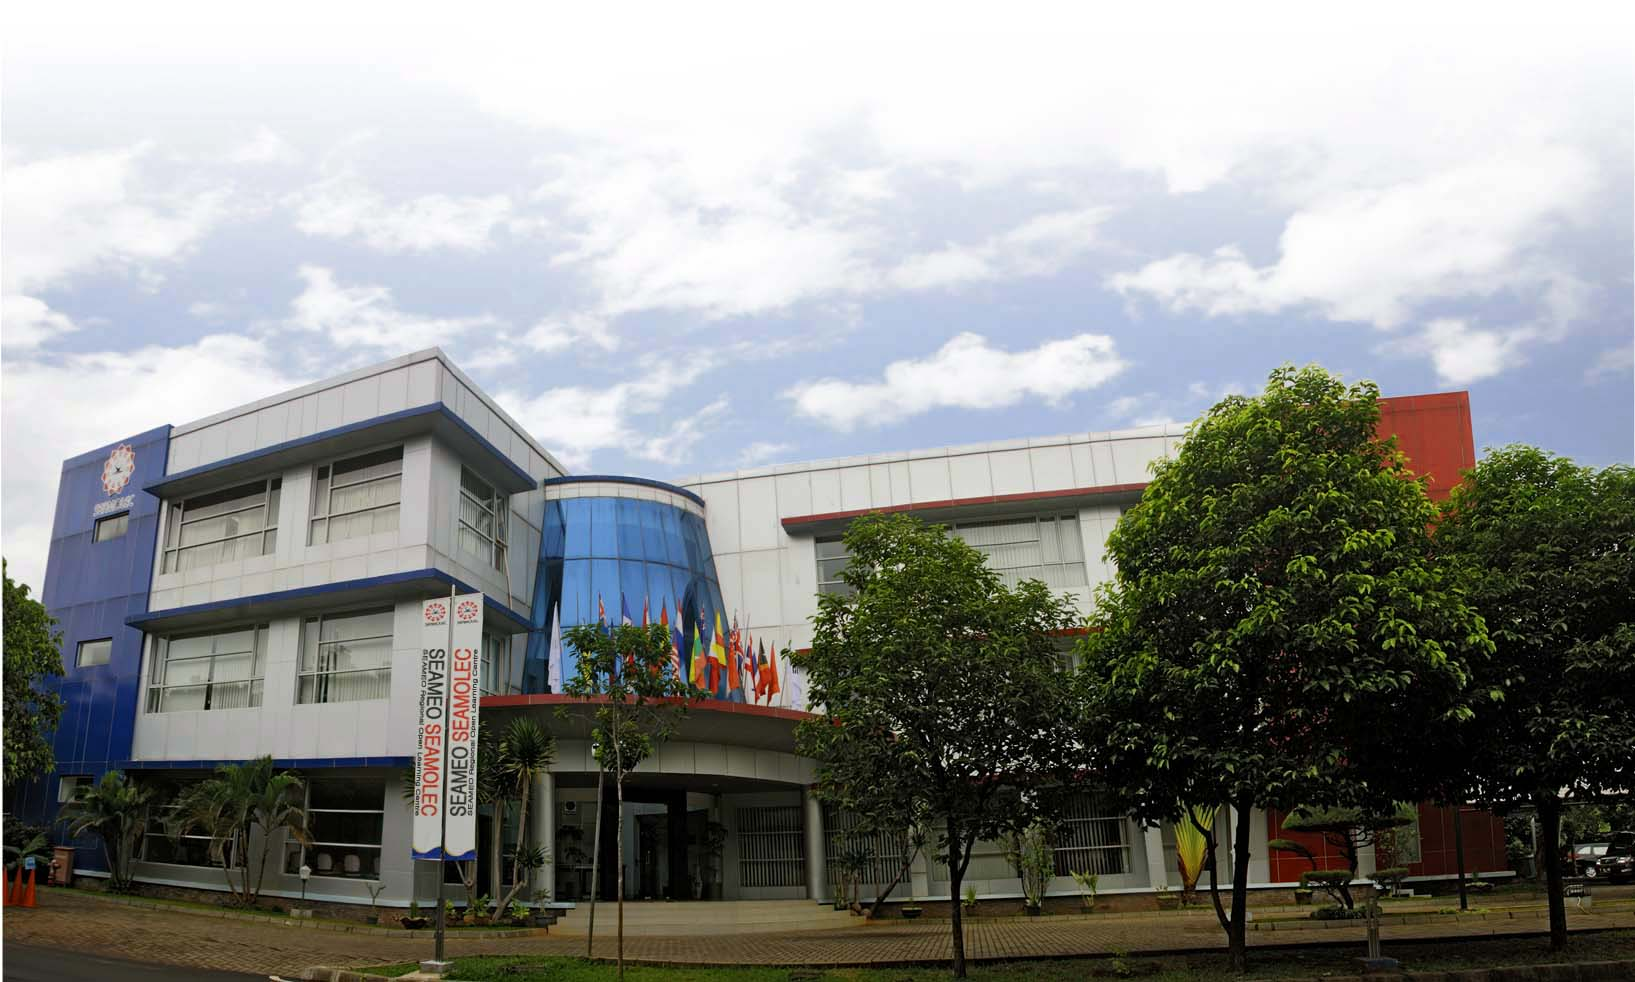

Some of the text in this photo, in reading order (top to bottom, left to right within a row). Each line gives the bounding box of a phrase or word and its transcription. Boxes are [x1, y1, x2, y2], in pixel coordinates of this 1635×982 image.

[426, 649, 445, 719] SEAMEO
[421, 724, 441, 816] SEAMOLEC
[450, 649, 471, 816] SEAMEO SEAMOLEC
